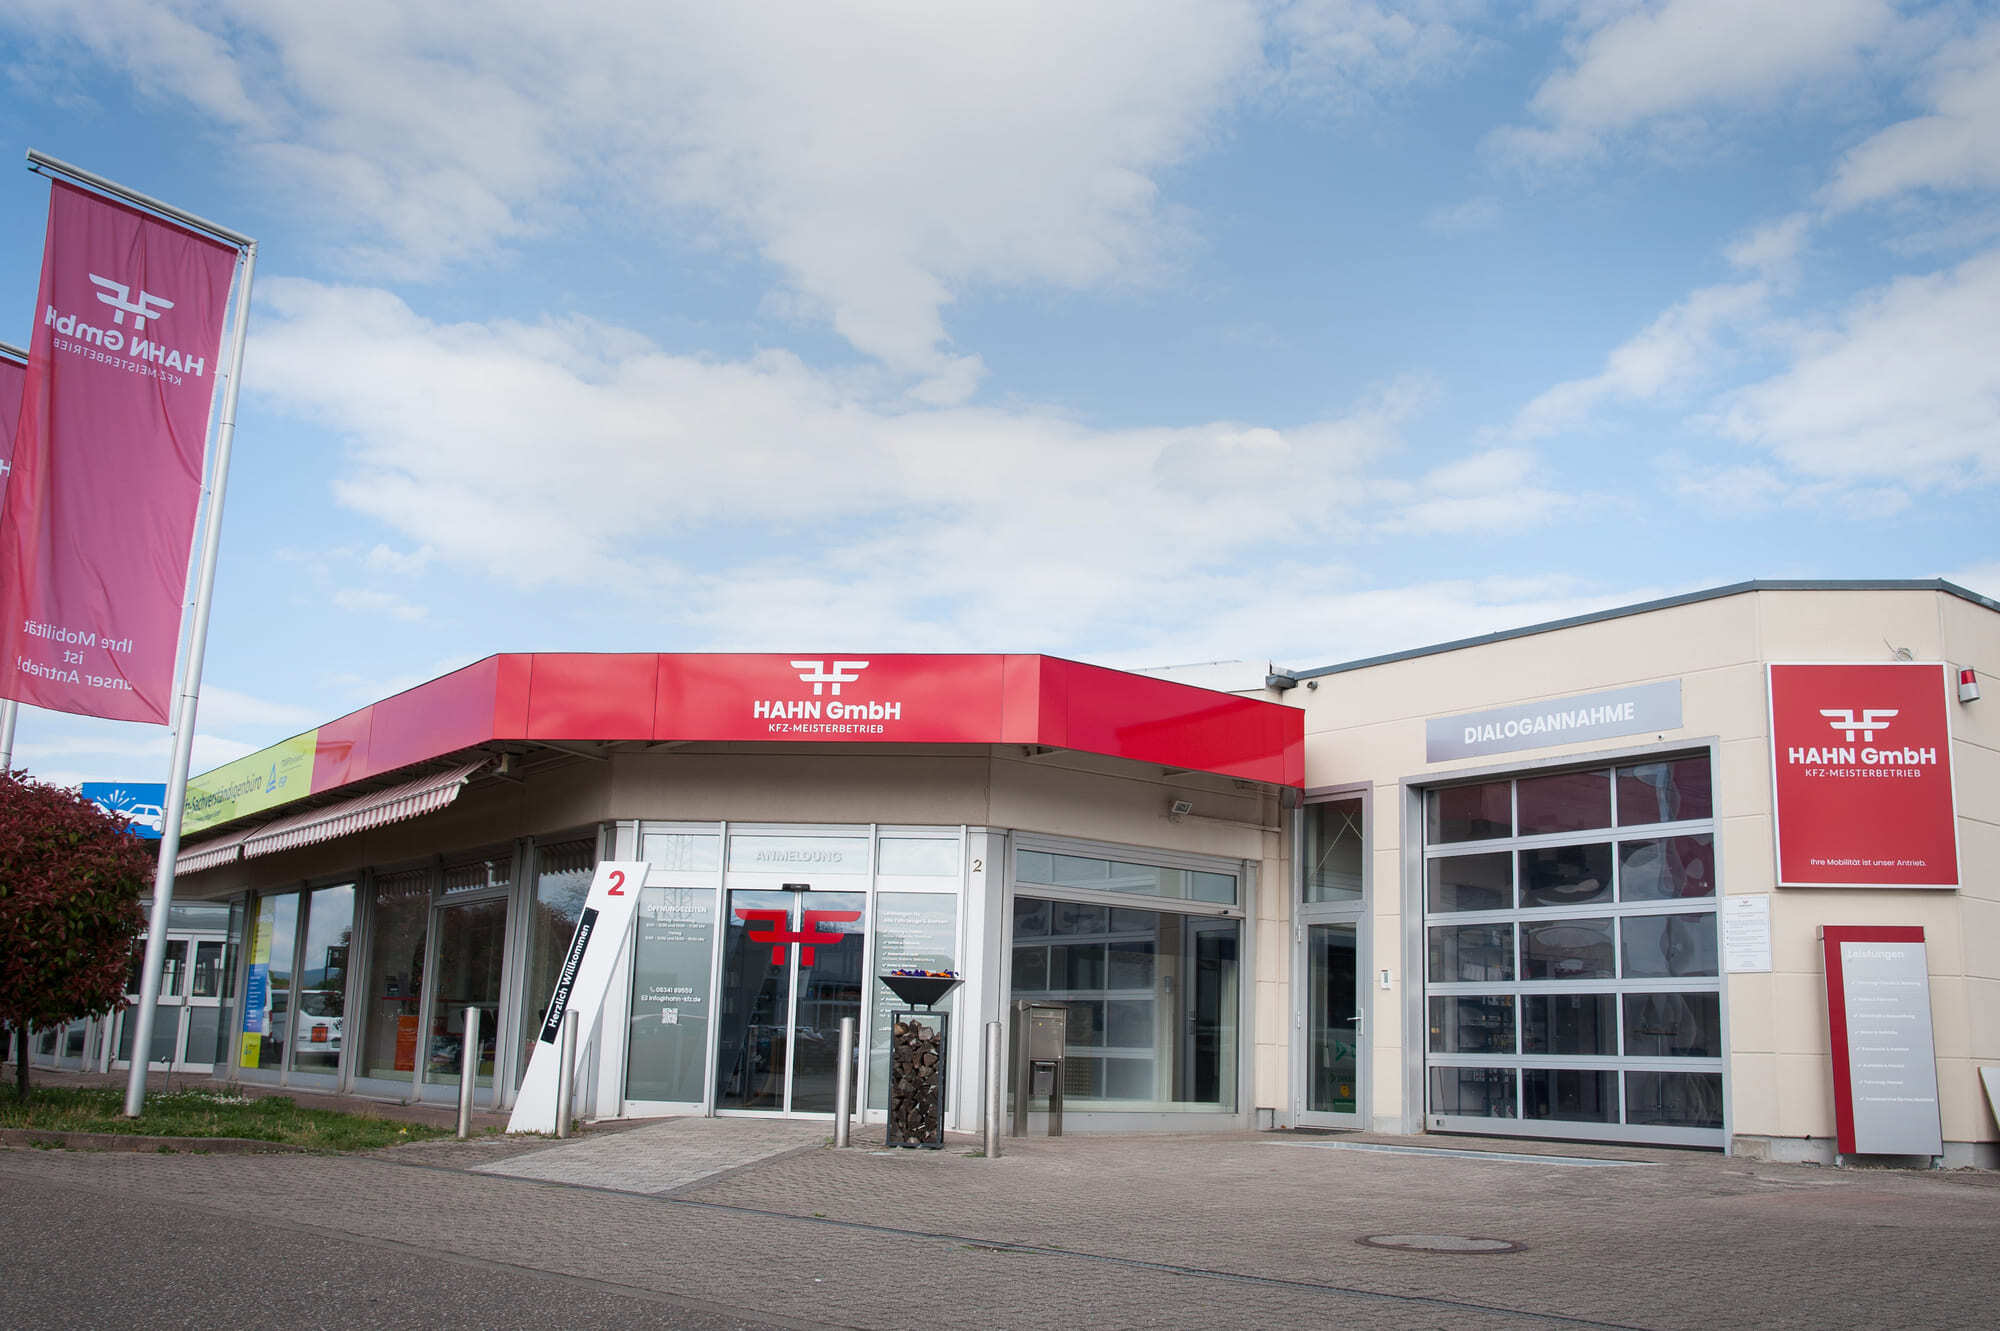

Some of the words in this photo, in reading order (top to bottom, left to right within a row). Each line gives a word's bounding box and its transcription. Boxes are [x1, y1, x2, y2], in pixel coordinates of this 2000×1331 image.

[753, 700, 821, 719] HAHN
[826, 700, 901, 720] GmbH
[768, 723, 884, 734] KFZ-MEISTERBETRIEB
[1464, 702, 1635, 745] DIALOGANNAHME
[1788, 747, 1856, 765] HAHN
[1861, 747, 1937, 765] GmbH
[1805, 768, 1921, 778] KFZ-MEISTERBETRIEB
[755, 850, 843, 863] ANMELDUNG
[1810, 858, 1825, 866] Ihre
[1827, 858, 1861, 866] Mobilität
[1862, 858, 1872, 866] ist
[1873, 859, 1895, 867] unser
[973, 859, 982, 872] 2
[608, 870, 625, 896] 2
[1848, 949, 1905, 961] Leistungen
[548, 987, 567, 1028] Herzlich
[561, 924, 590, 986] Willkommen
